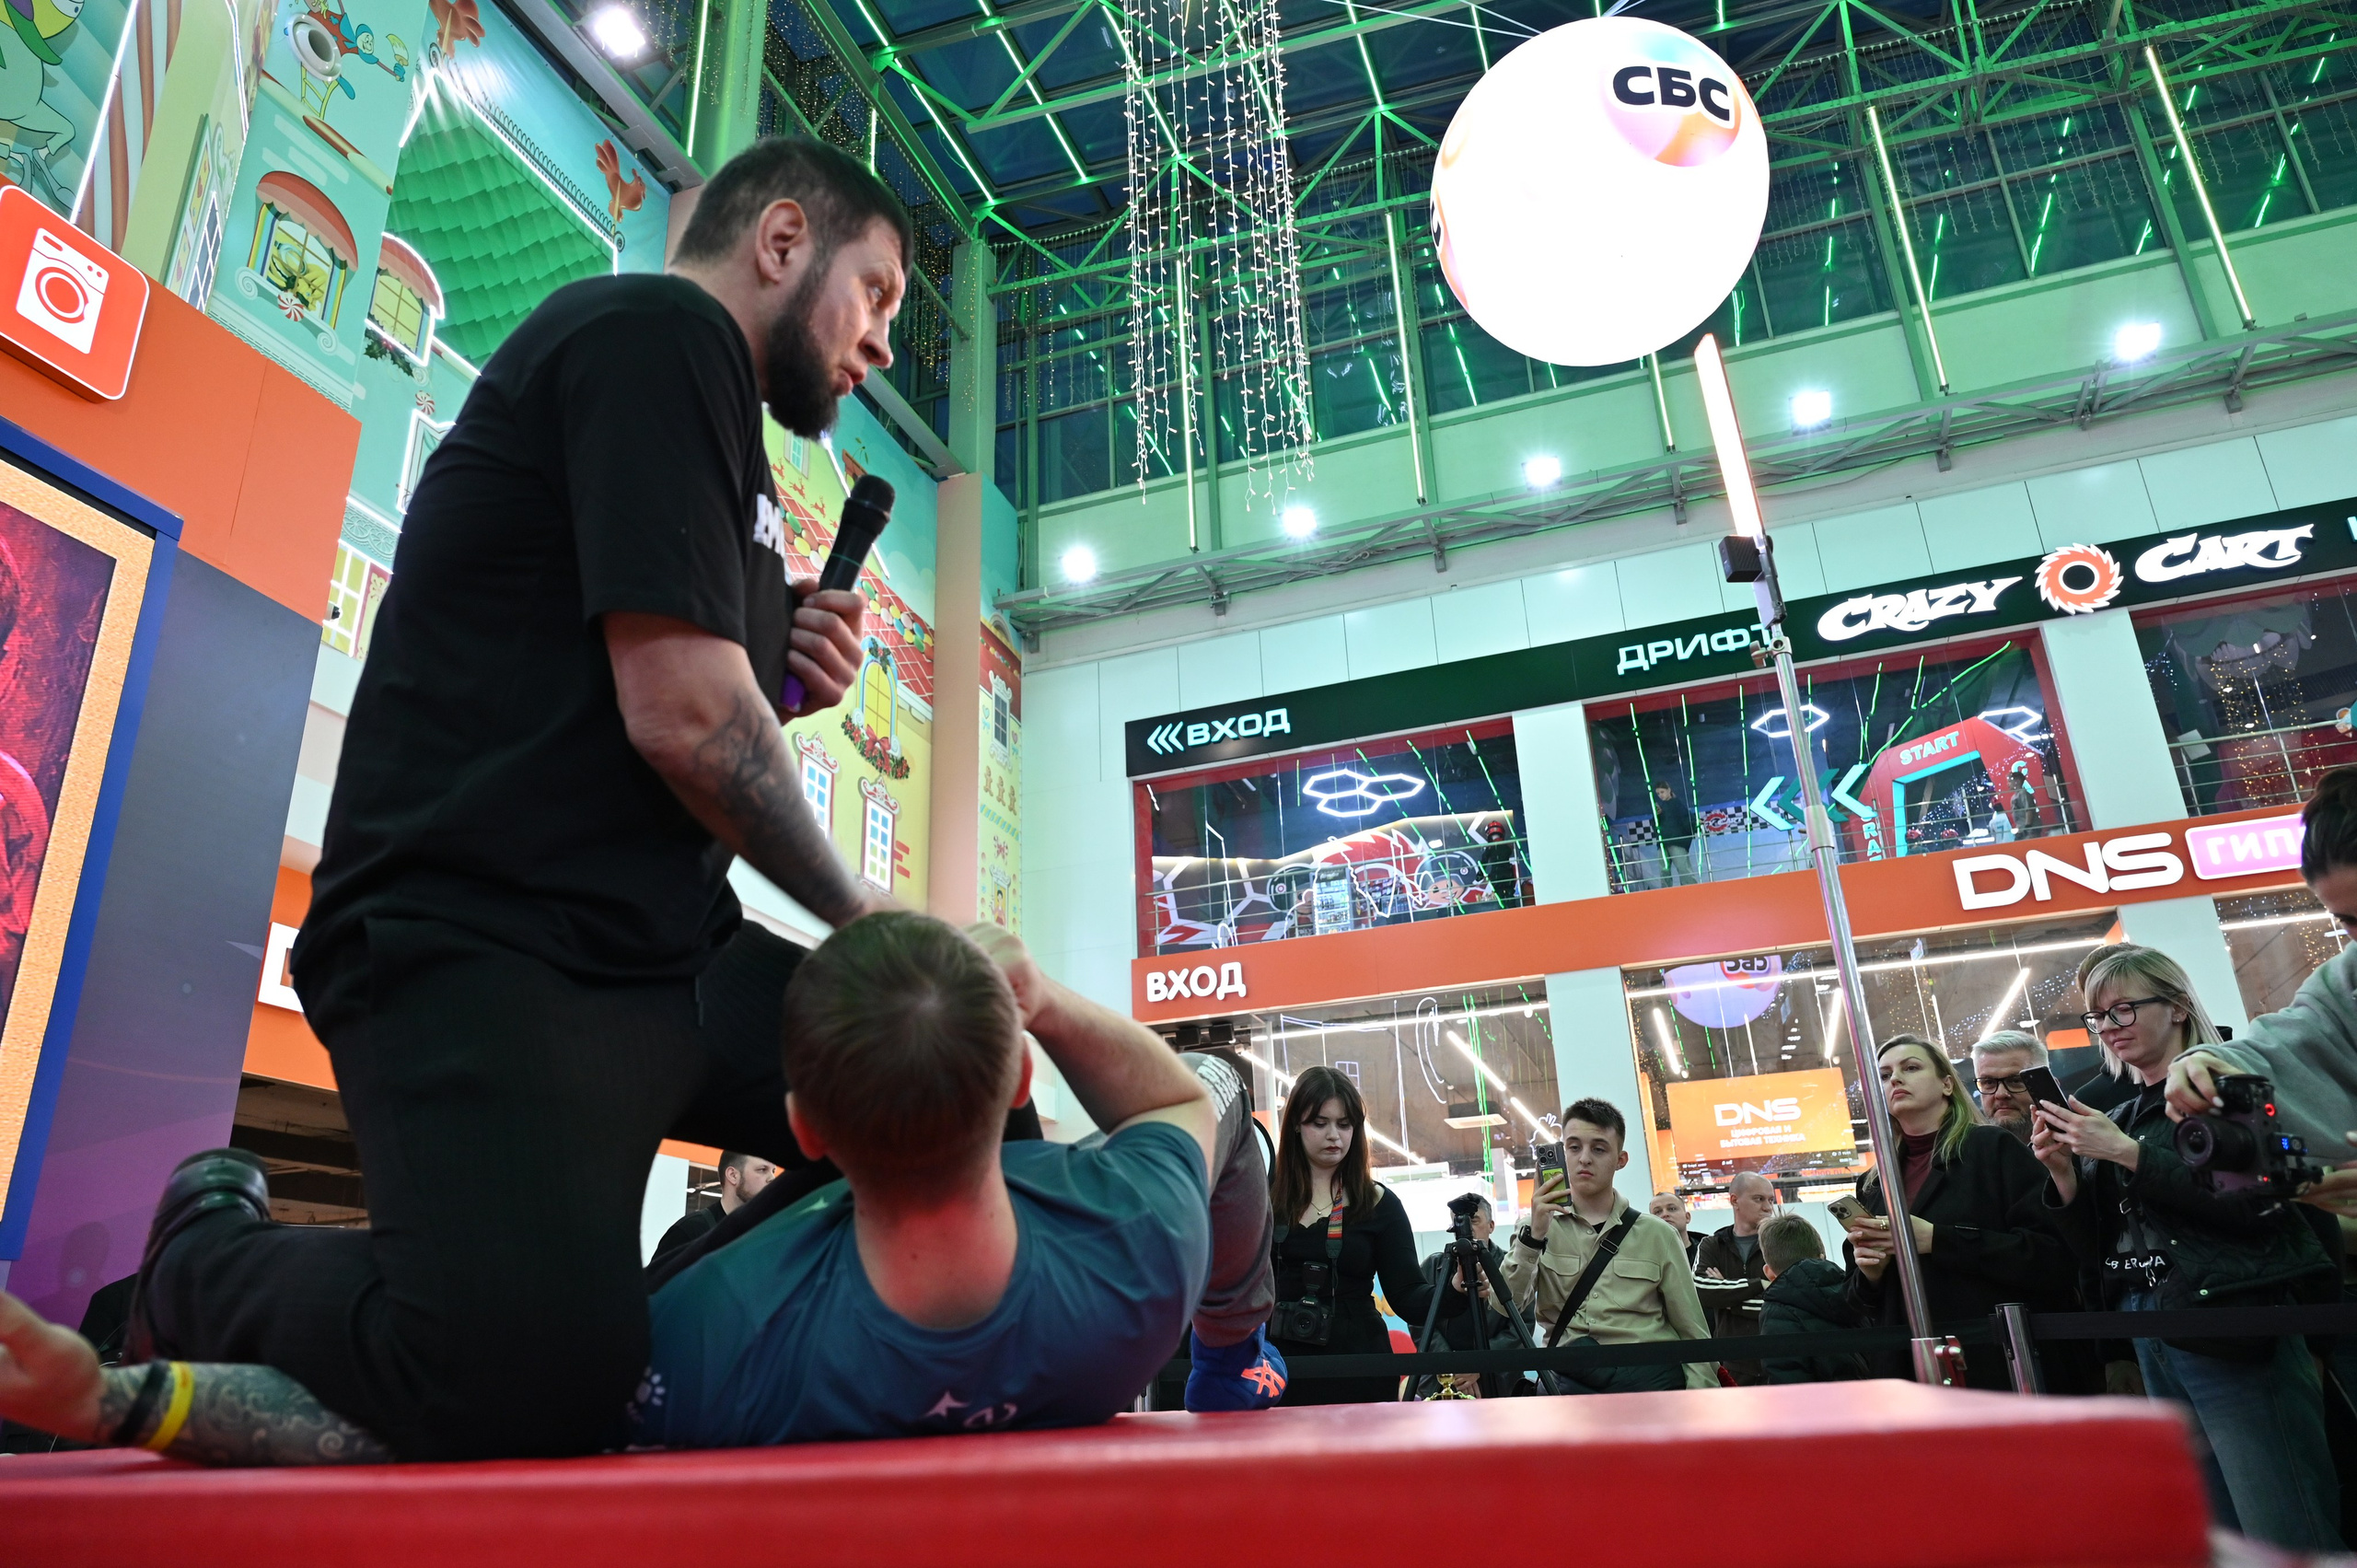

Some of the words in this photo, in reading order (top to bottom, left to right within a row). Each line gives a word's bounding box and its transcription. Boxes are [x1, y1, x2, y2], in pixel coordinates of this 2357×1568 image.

[1613, 65, 1730, 122] СБС
[1817, 575, 2024, 642] CRAZY
[2134, 523, 2316, 584] CART
[1617, 622, 1773, 675] ДРИФТ
[1187, 707, 1291, 747] ВХОД
[1899, 730, 1959, 765] START
[2206, 825, 2306, 865] ГИП
[1952, 831, 2184, 911] DNS
[1146, 961, 1247, 1003] ВХОД
[1713, 1097, 1802, 1127] DNS
[1731, 1125, 1782, 1138] ЦИФРОВАЯ
[1783, 1124, 1792, 1133] И
[1720, 1137, 1763, 1149] БЫТОВАЯ
[1763, 1132, 1806, 1144] ТЕХНИКА
